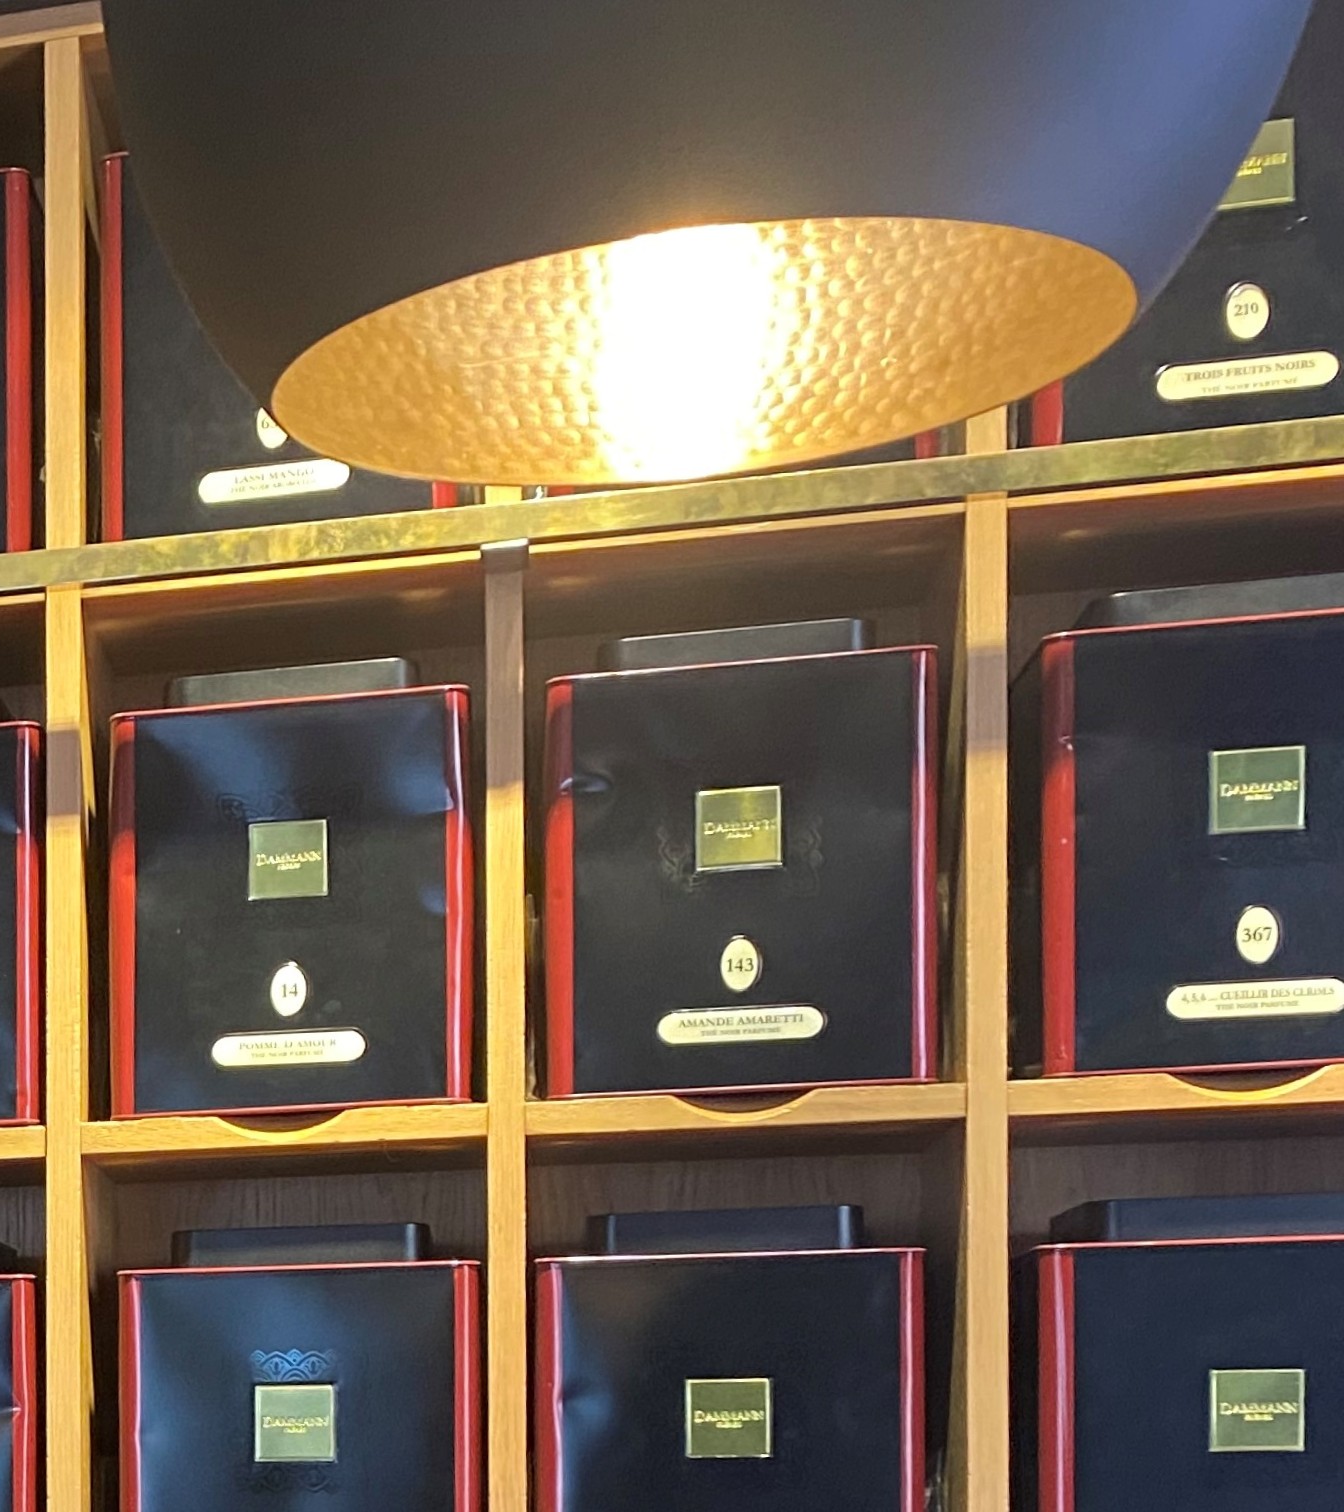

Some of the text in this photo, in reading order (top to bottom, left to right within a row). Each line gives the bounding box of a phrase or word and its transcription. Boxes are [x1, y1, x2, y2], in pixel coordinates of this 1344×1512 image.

[1234, 303, 1259, 317] 210
[1184, 359, 1316, 382] TROIS FRUITS NOIRS
[1243, 926, 1272, 942] 367
[727, 957, 754, 972] 143
[281, 983, 298, 998] 14
[1219, 989, 1268, 1001] CUEILLIR
[1270, 988, 1291, 998] DES
[678, 1013, 805, 1028] AMANDE AMARETTI
